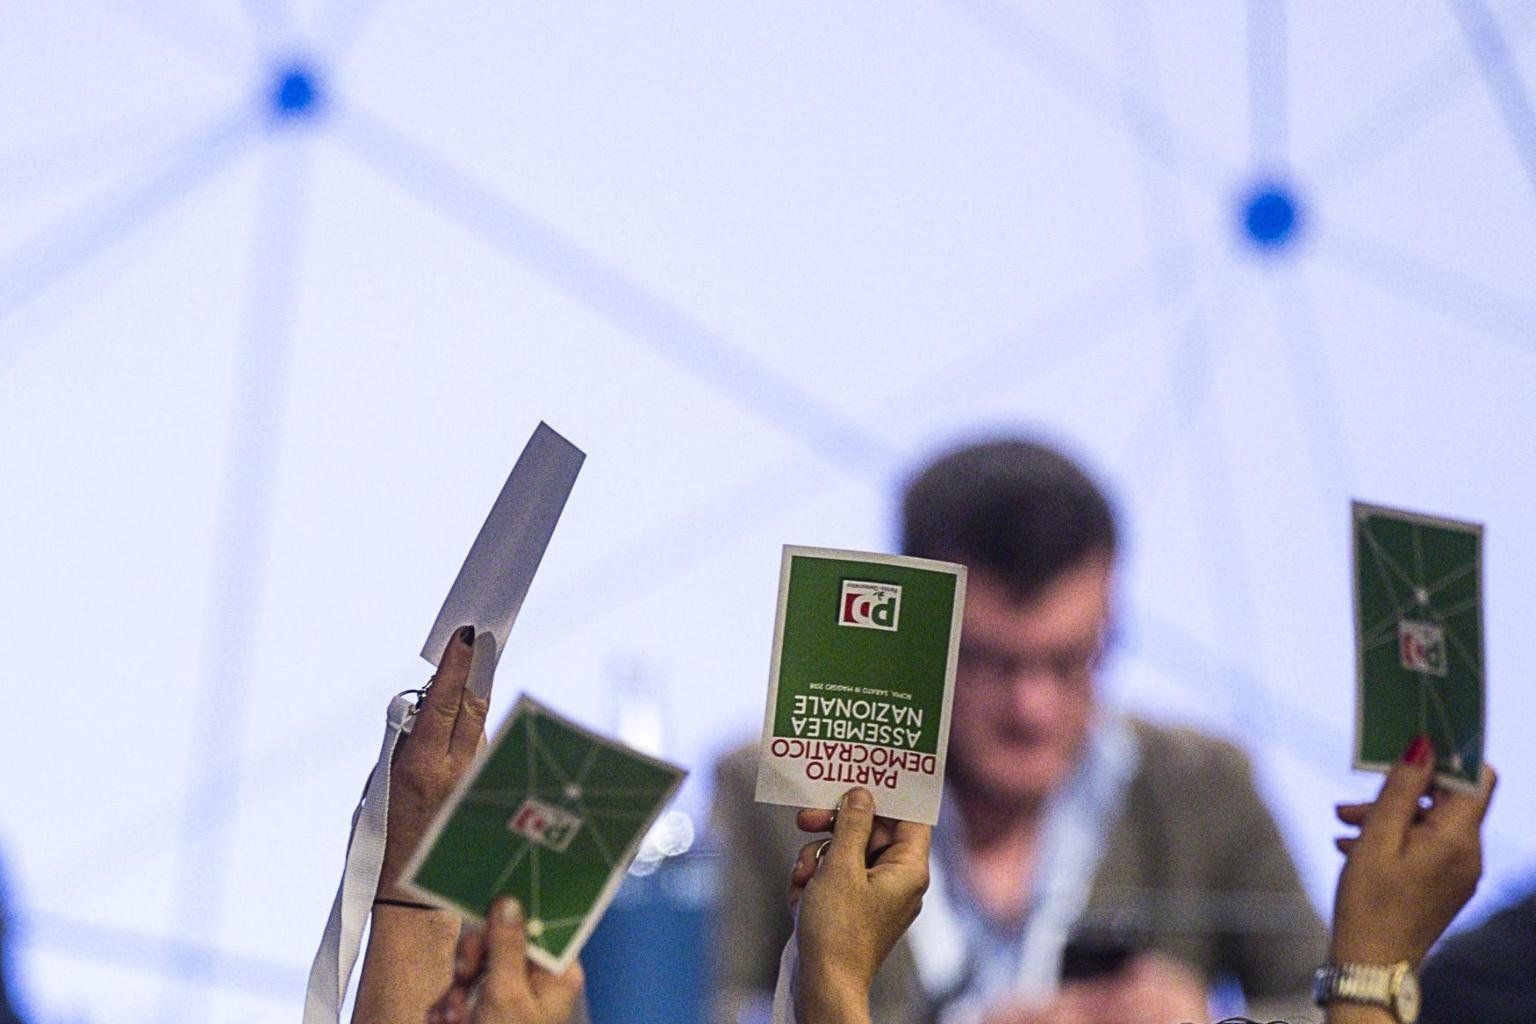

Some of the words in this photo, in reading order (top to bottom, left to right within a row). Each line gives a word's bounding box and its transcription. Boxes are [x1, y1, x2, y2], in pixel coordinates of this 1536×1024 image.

[844, 593, 896, 627] PD
[794, 695, 923, 727] NAZIONALE
[791, 716, 922, 748] ASSEMBLEA
[771, 739, 936, 775] DEMOCRATICO
[806, 761, 898, 789] PARTITO
